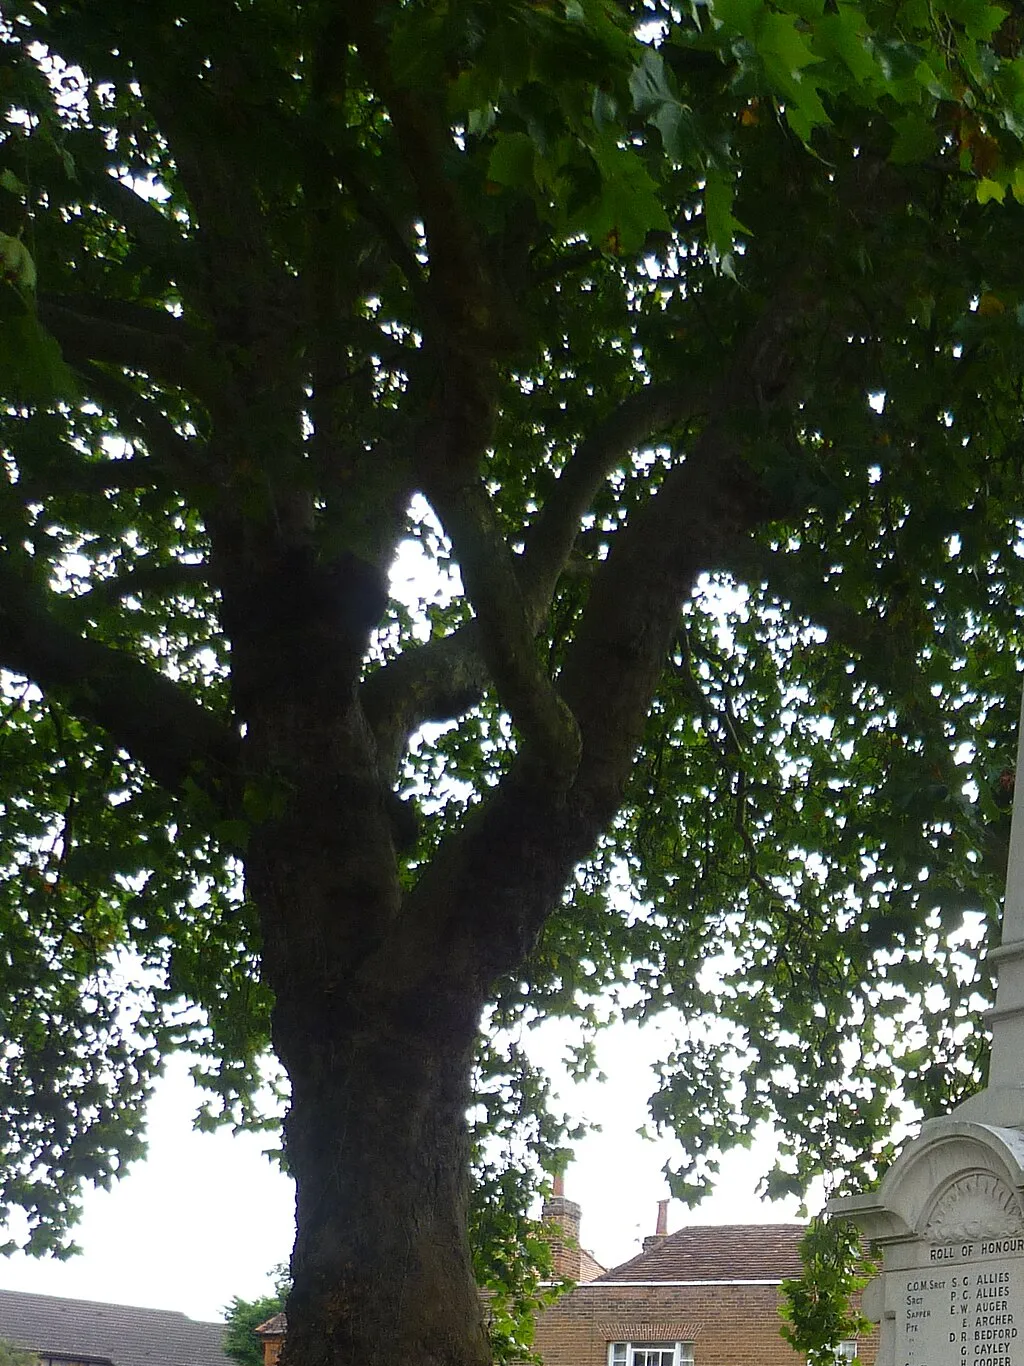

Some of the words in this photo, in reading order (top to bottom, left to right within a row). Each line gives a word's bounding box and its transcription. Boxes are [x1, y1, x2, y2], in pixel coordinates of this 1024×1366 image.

[930, 1248, 954, 1260] ROLL
[961, 1245, 973, 1257] OF
[981, 1239, 1024, 1254] HONOUR
[976, 1272, 1010, 1285] ALLIES
[976, 1286, 1010, 1299] ALLIES
[976, 1301, 1008, 1312] AUGER
[975, 1314, 1013, 1327] ARCHER
[974, 1328, 1018, 1340] BEDFORD
[974, 1342, 1010, 1354] CAYLEY
